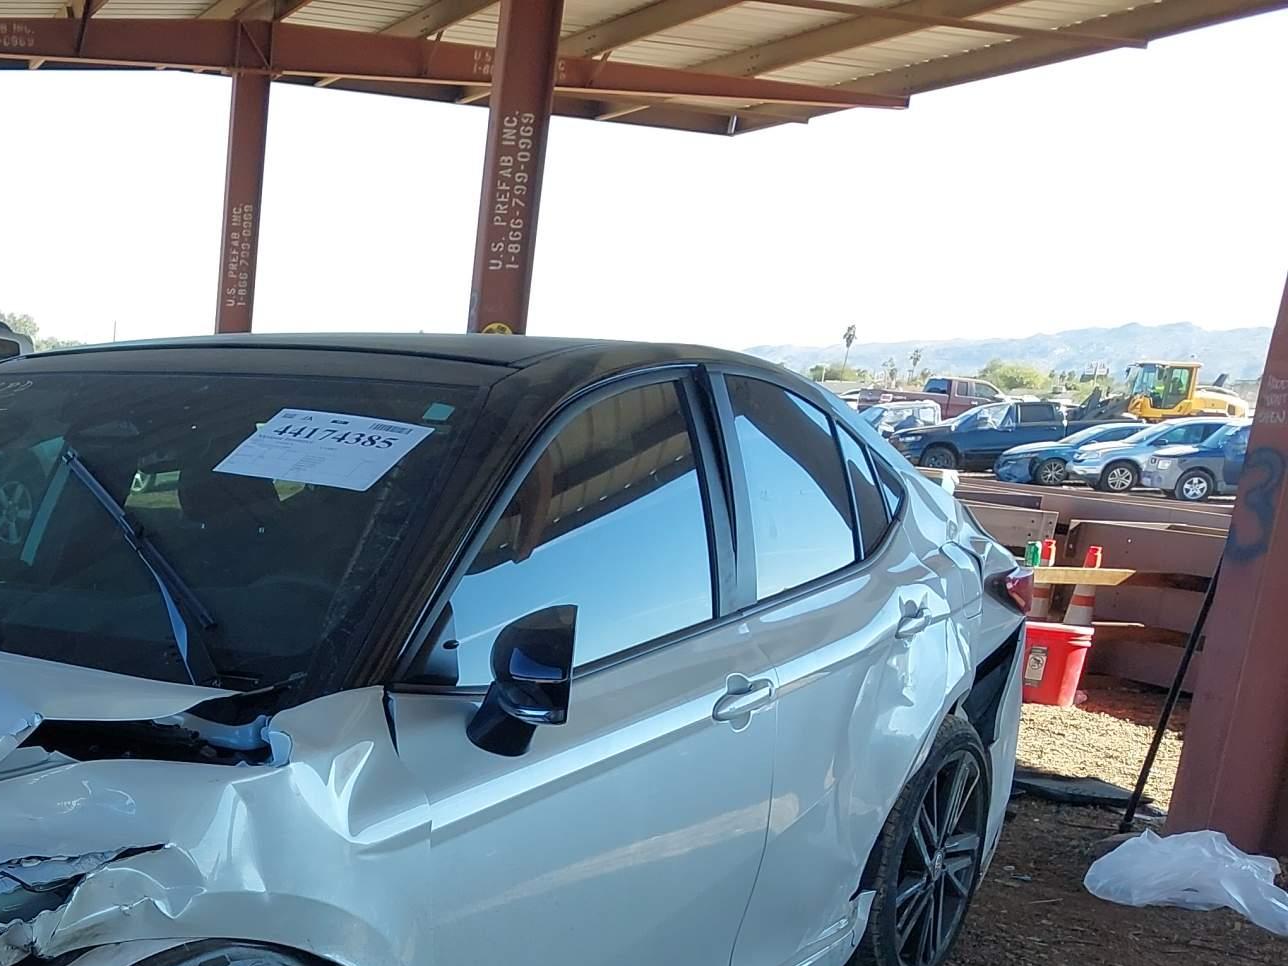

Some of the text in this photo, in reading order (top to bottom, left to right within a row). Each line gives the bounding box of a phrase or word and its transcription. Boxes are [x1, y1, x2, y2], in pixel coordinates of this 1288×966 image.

[488, 110, 520, 271] U.S. PREFAB INC.
[505, 112, 536, 270] 1-866-799-0969
[228, 232, 240, 279] PREFAB
[273, 424, 399, 449] 44174385
